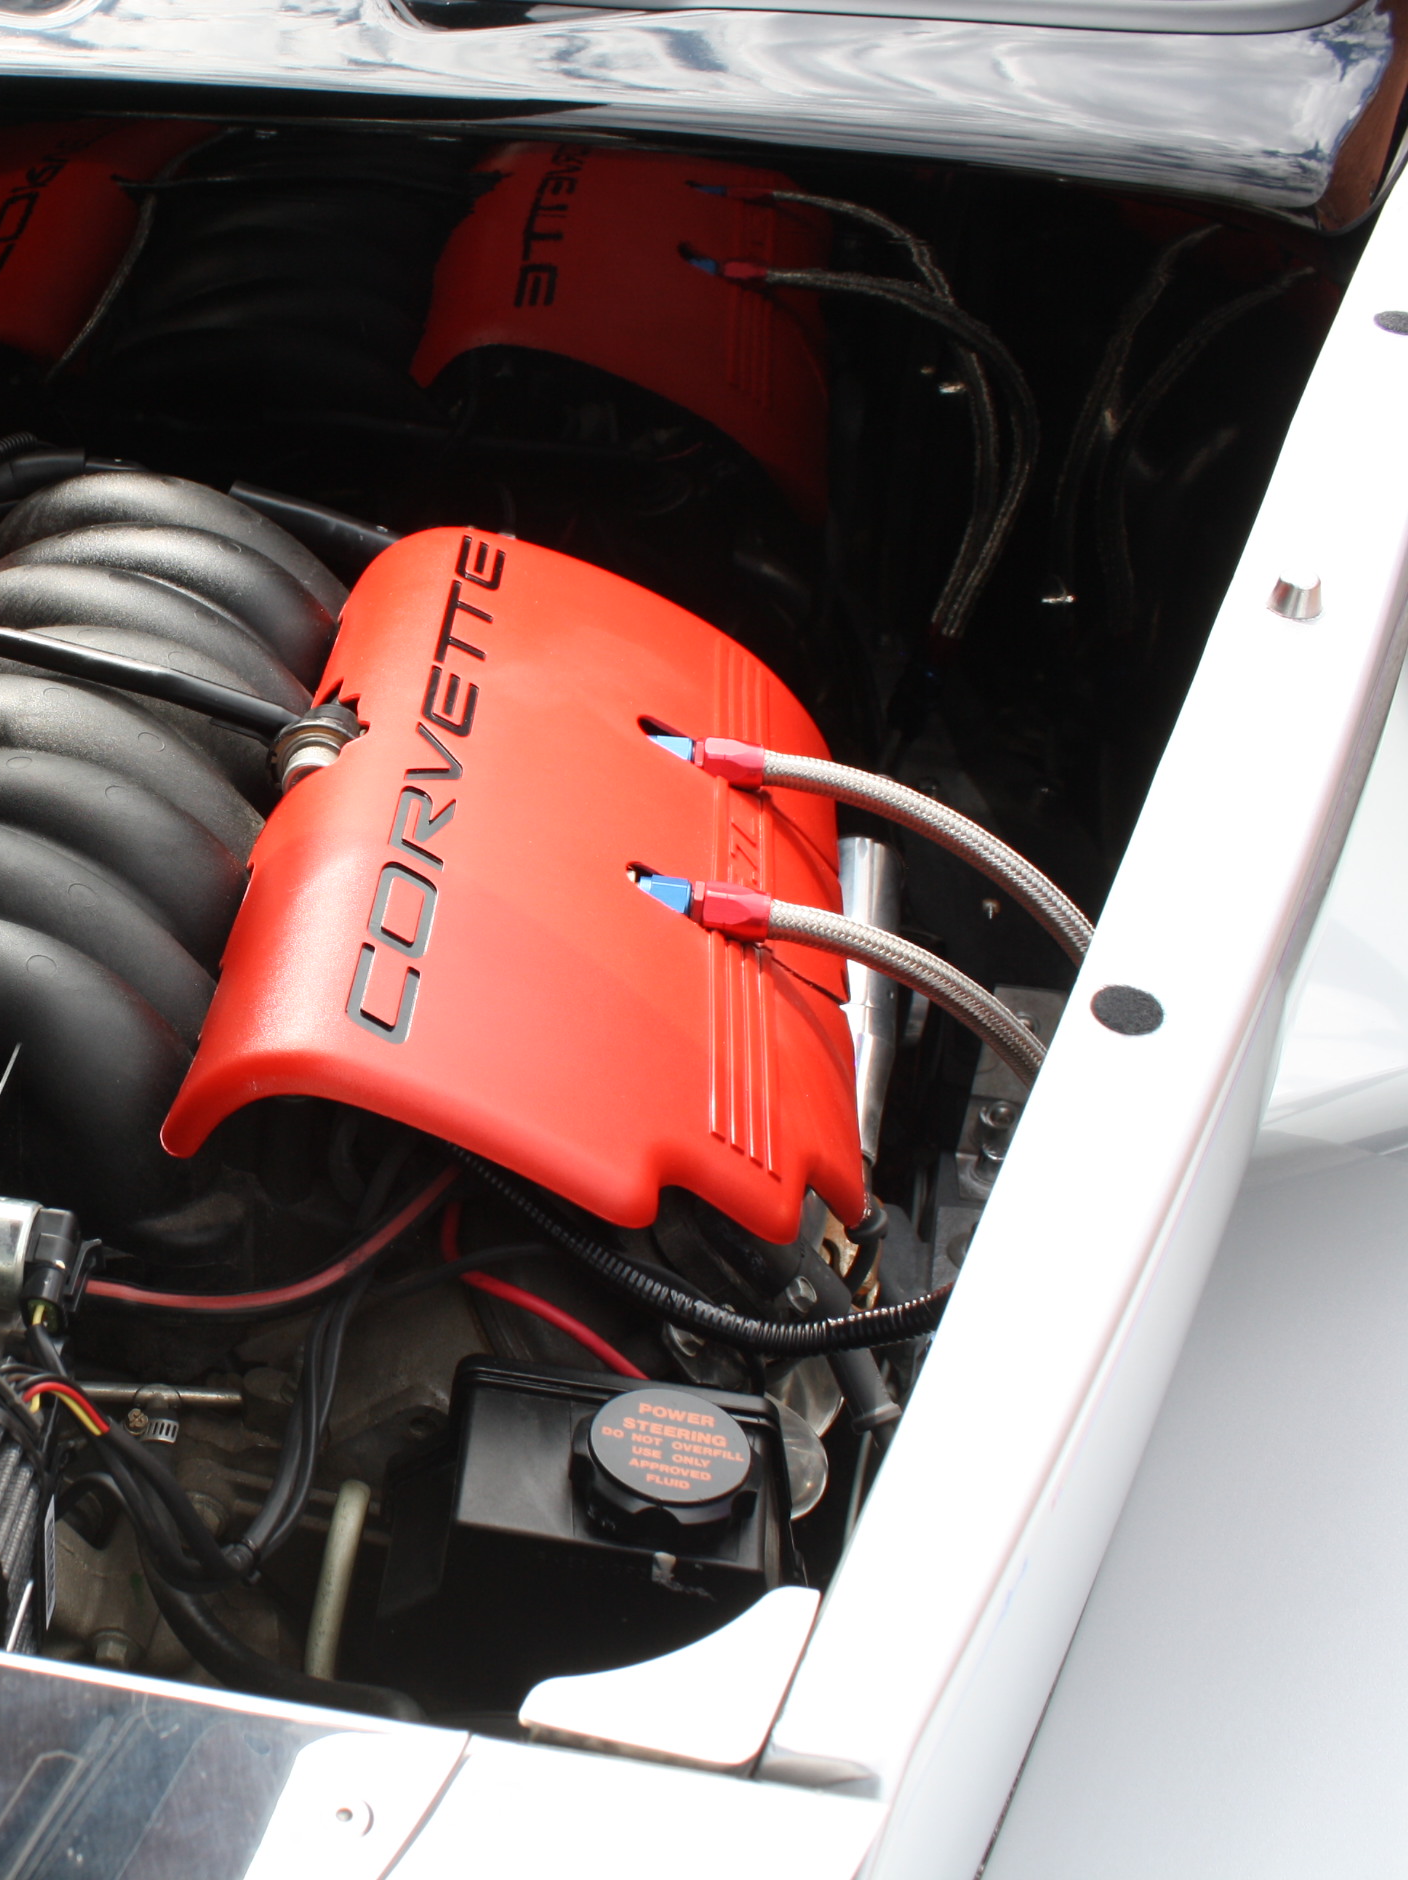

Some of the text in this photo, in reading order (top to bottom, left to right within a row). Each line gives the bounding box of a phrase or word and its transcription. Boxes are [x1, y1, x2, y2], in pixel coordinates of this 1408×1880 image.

[346, 535, 506, 1044] CORVETTE
[639, 1402, 715, 1428] POWER
[601, 1426, 744, 1462] DO NOT OVERFILL
[622, 1417, 727, 1448] STEERING
[629, 1459, 712, 1481] APPROVED
[631, 1446, 711, 1468] USE ONLY
[646, 1474, 691, 1490] FLUID
